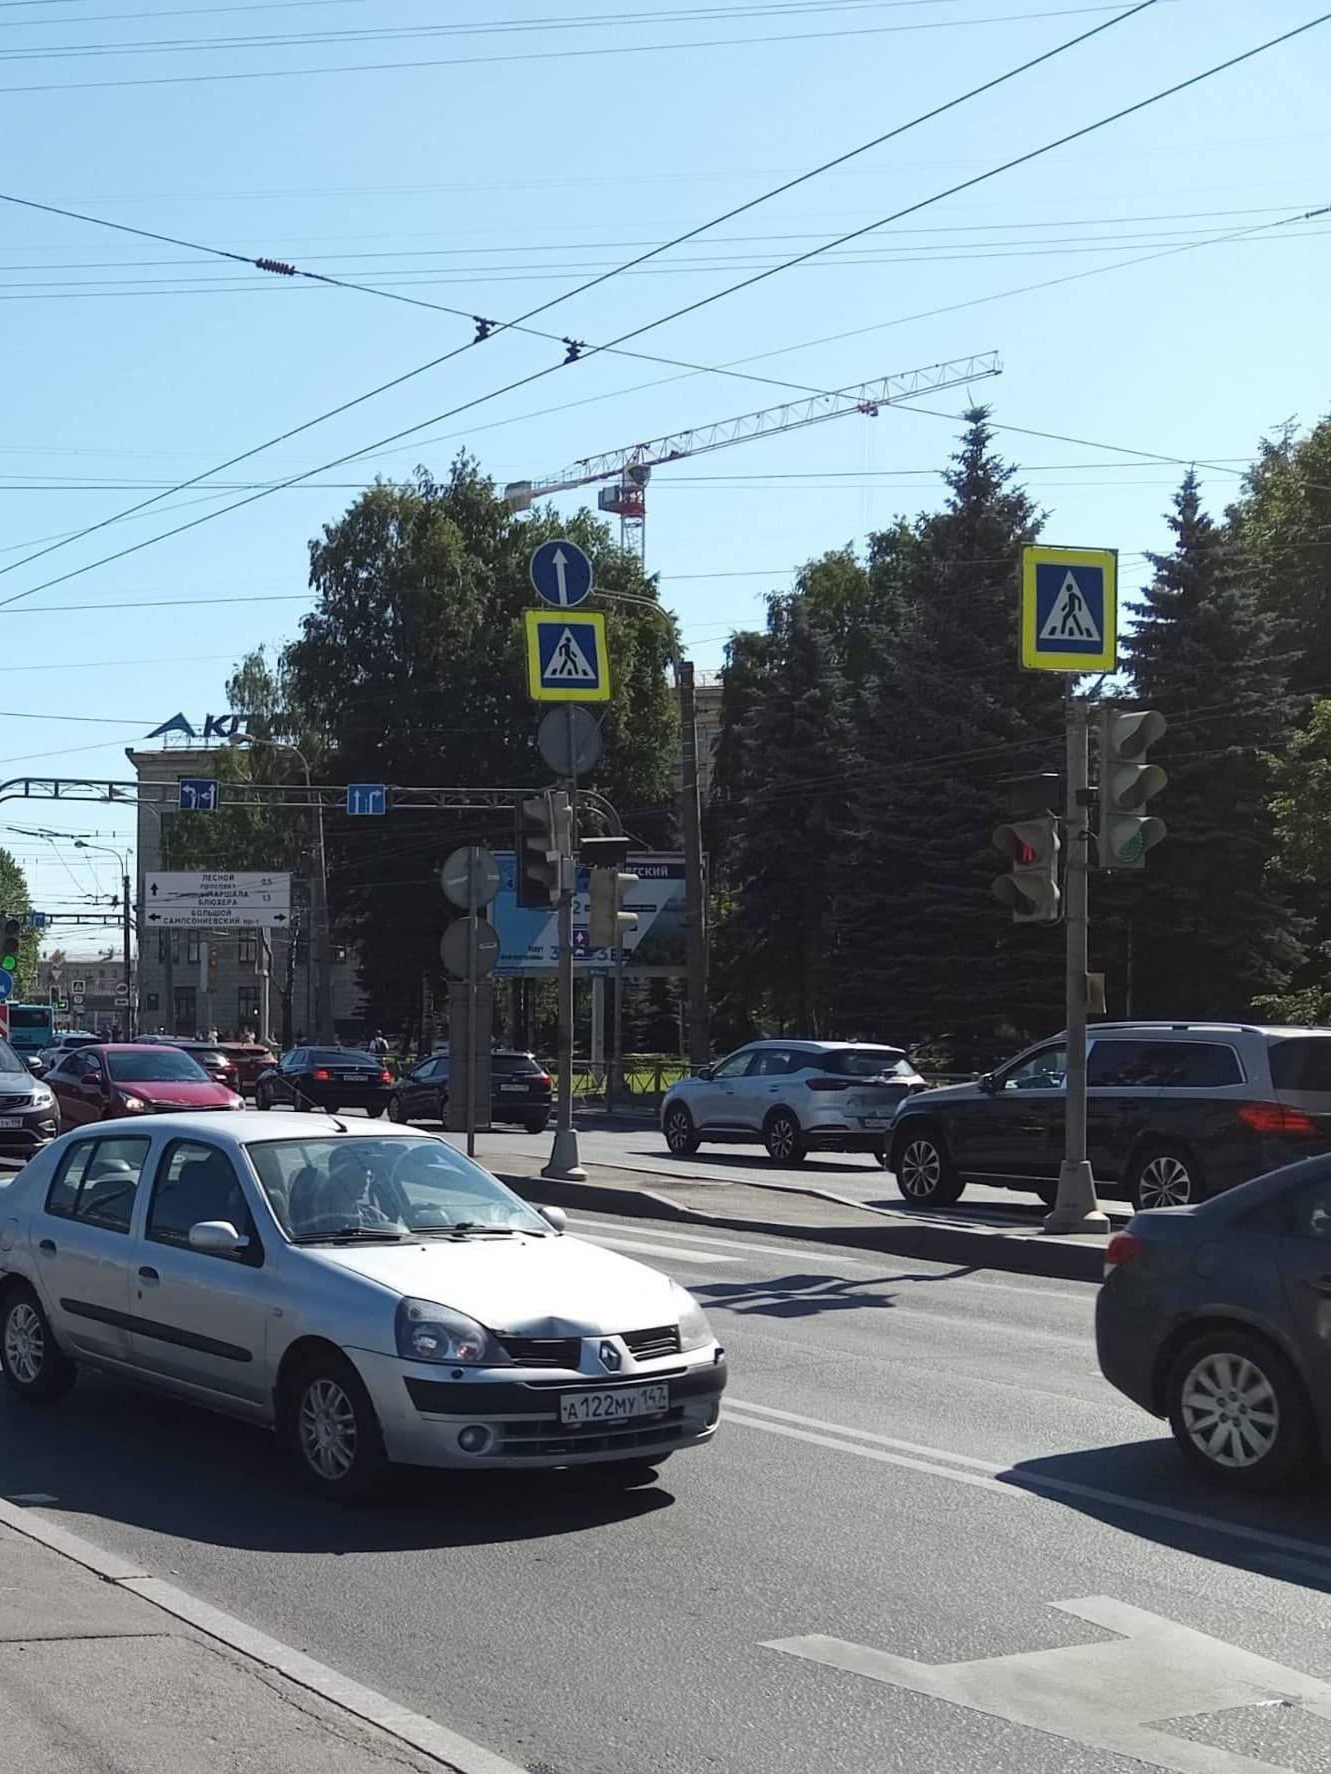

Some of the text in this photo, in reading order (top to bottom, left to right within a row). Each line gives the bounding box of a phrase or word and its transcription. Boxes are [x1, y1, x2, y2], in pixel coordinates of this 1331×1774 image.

[202, 873, 235, 882] ЛЕСНОЙ
[198, 898, 238, 906] БЛЮХЕРА
[191, 909, 232, 917] БОЛЬШОЙ
